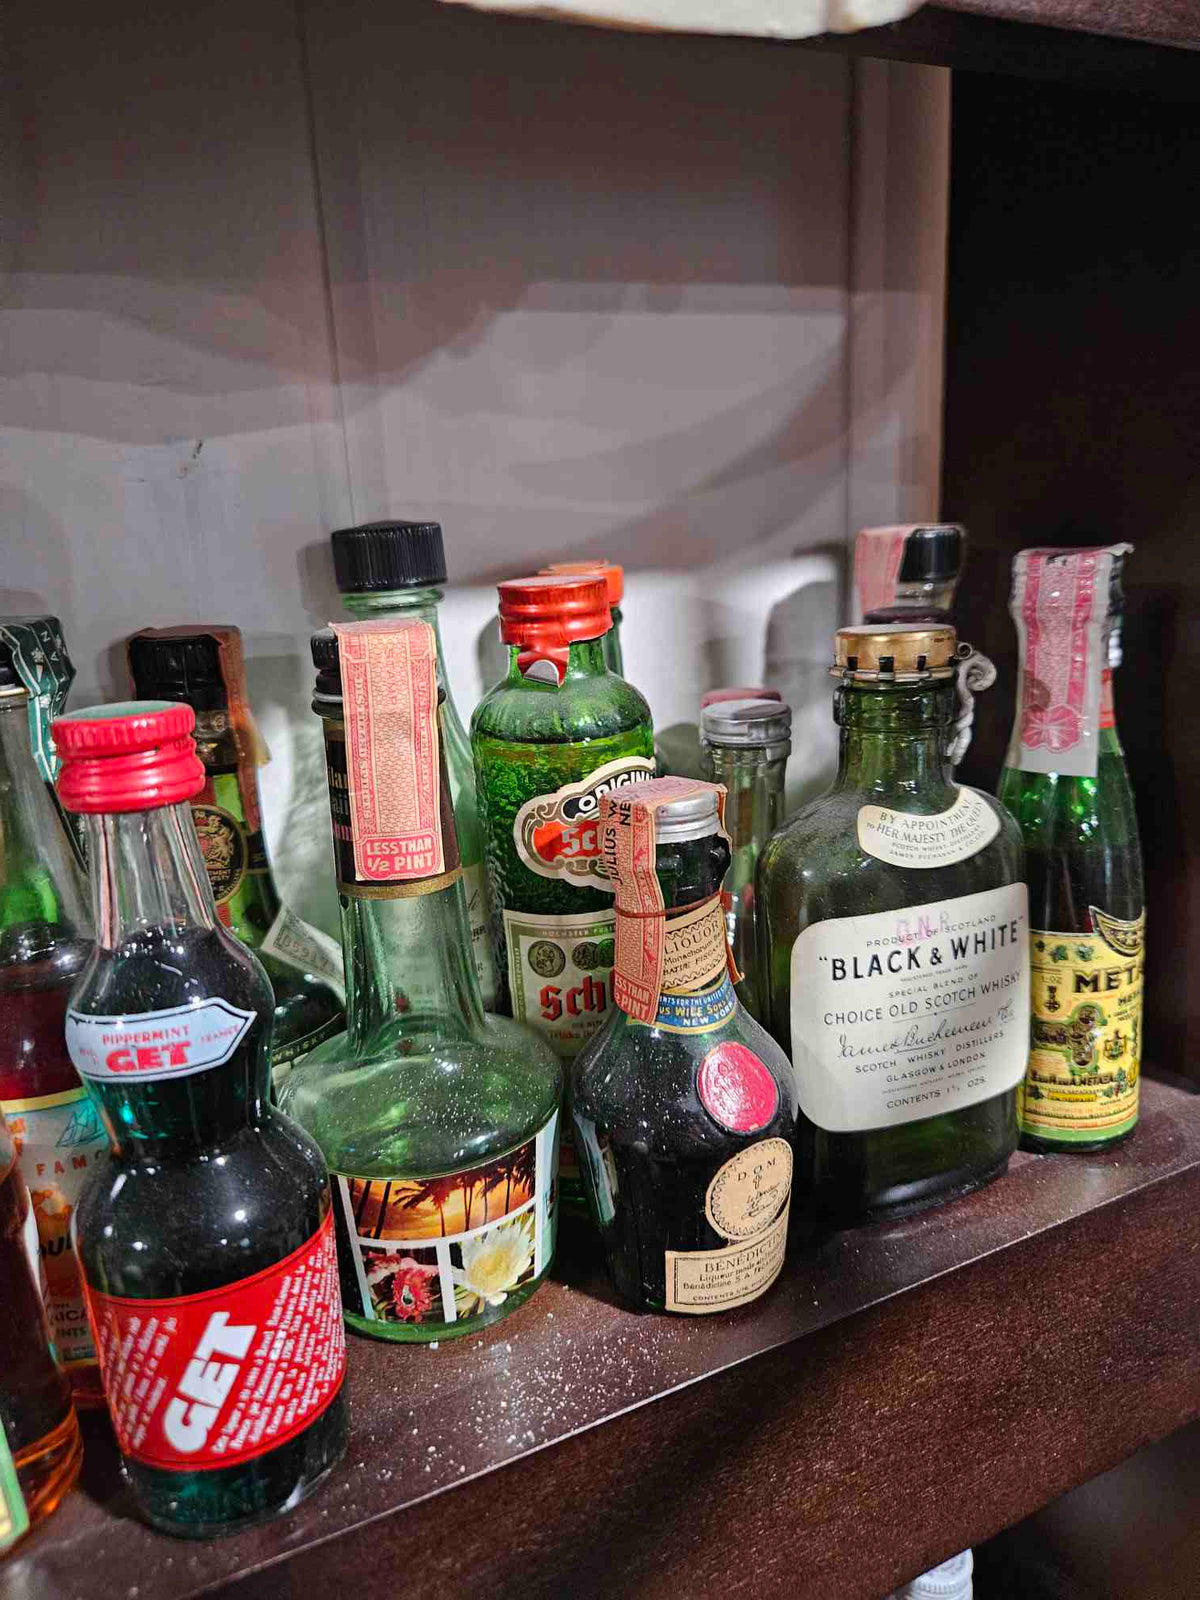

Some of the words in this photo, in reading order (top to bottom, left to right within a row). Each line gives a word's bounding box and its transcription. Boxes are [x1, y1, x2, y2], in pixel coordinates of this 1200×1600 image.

[880, 811, 897, 824] BY
[876, 824, 899, 839] HER
[901, 831, 946, 844] MAJESTY
[950, 825, 966, 838] THE
[365, 840, 398, 856] LESS
[398, 838, 433, 853] THAN
[603, 828, 623, 886] JULIUS
[394, 850, 434, 871] PINT
[867, 931, 920, 948] PRODUCT
[926, 929, 939, 938] OF
[944, 914, 996, 933] SCOTLAND
[930, 947, 943, 965] &
[627, 981, 650, 1004] THAN
[888, 986, 929, 998] SPECIAL
[933, 977, 963, 990] BLEND
[967, 972, 979, 981] OF
[621, 993, 650, 1020] PINT
[824, 1007, 884, 1026] CHOICE
[889, 1002, 919, 1018] OLD
[925, 986, 977, 1010] SCOTCH
[980, 970, 1022, 996] WHISKY
[683, 1015, 709, 1026] NEW
[713, 1001, 735, 1020] YORK
[103, 1023, 190, 1046] PIPPERMINT
[105, 1041, 192, 1073] GET
[855, 1060, 897, 1074] SCOTCH
[907, 1049, 946, 1065] WHISKY
[955, 1031, 1005, 1052] DISTILLERS
[886, 1067, 938, 1083] GLASGOW
[947, 1052, 987, 1069] LONDON
[886, 1089, 941, 1109] CONTENTS
[700, 1270, 734, 1283] Liqueur
[163, 1311, 257, 1454] GET
